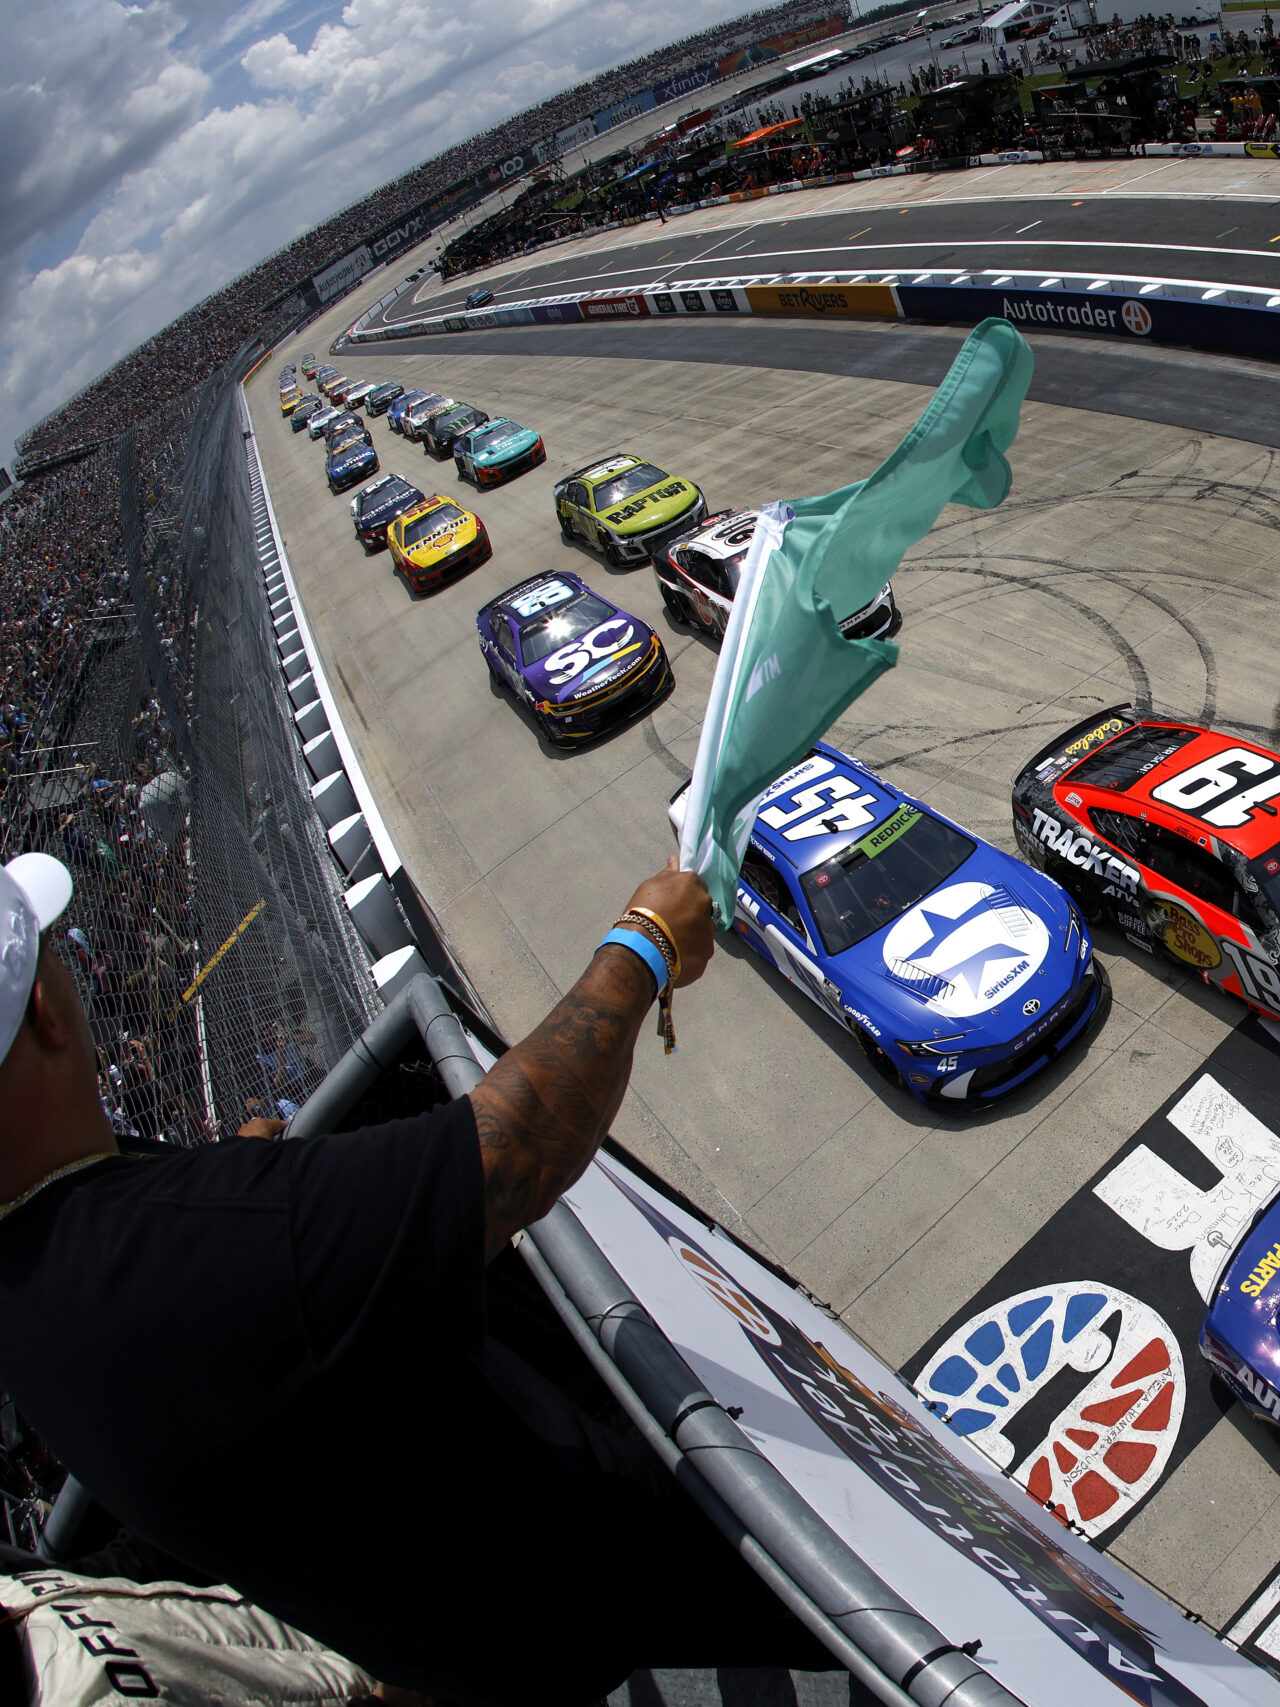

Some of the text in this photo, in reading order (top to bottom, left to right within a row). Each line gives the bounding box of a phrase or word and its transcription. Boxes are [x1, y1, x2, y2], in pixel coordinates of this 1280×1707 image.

[663, 69, 711, 99] xfinity
[1002, 297, 1118, 329] Autotrader
[606, 480, 688, 526] RAPTOR
[406, 516, 472, 557] PENNZOIL
[574, 656, 643, 701] WeatherTech.com
[1065, 717, 1124, 755] Cabela's
[757, 775, 881, 842] 45
[869, 808, 916, 849] REDDICK
[1031, 807, 1143, 897] TRACKER
[1117, 916, 1147, 937] COFFEE
[1168, 905, 1201, 935] Bass
[1172, 921, 1196, 944] Pro
[1173, 933, 1214, 967] Shops
[984, 959, 1031, 1001] SiriusXM
[844, 1003, 882, 1038] GOODYEAR
[1013, 1000, 1070, 1051] CAMRY
[936, 1055, 959, 1074] 45
[1100, 1408, 1137, 1446] HUNTER
[813, 1361, 1074, 1593] EchoPark
[1061, 1447, 1100, 1489] HUDSON
[772, 1353, 1165, 1684] Autotrader
